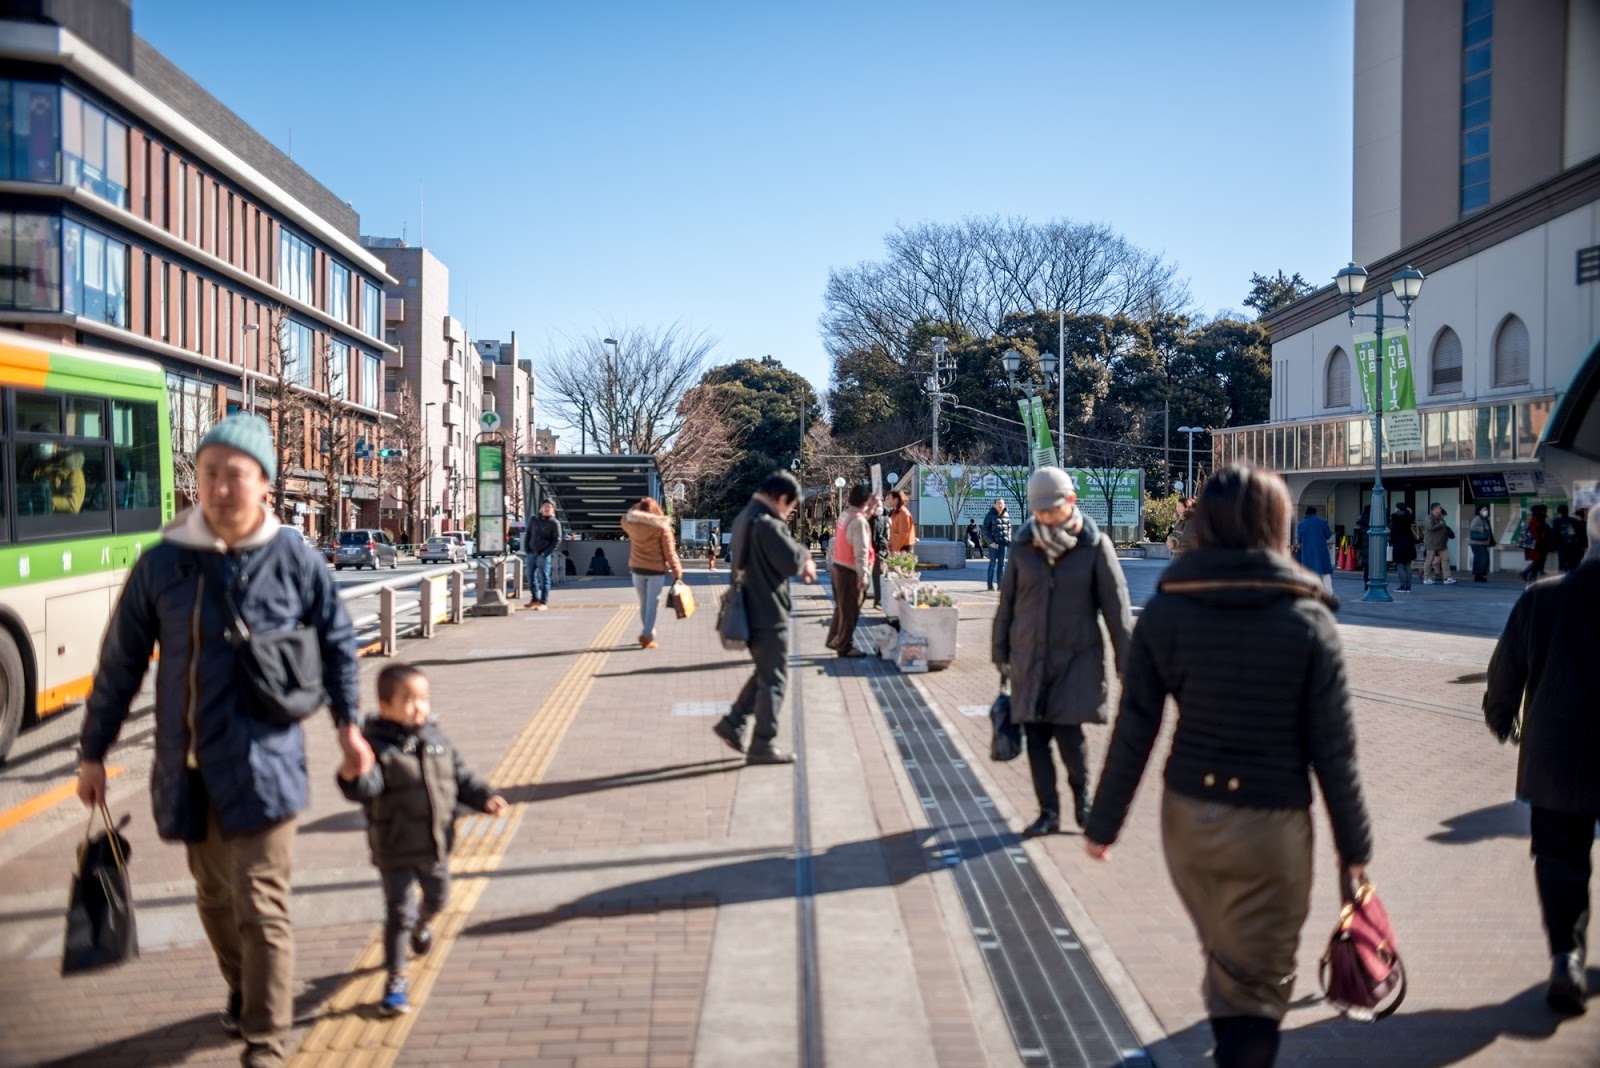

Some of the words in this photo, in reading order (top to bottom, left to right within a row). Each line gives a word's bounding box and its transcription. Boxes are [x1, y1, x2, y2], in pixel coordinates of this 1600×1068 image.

[1359, 350, 1373, 413] ロードレース
[1388, 345, 1401, 411] ロードレース
[1397, 343, 1407, 369] 目白
